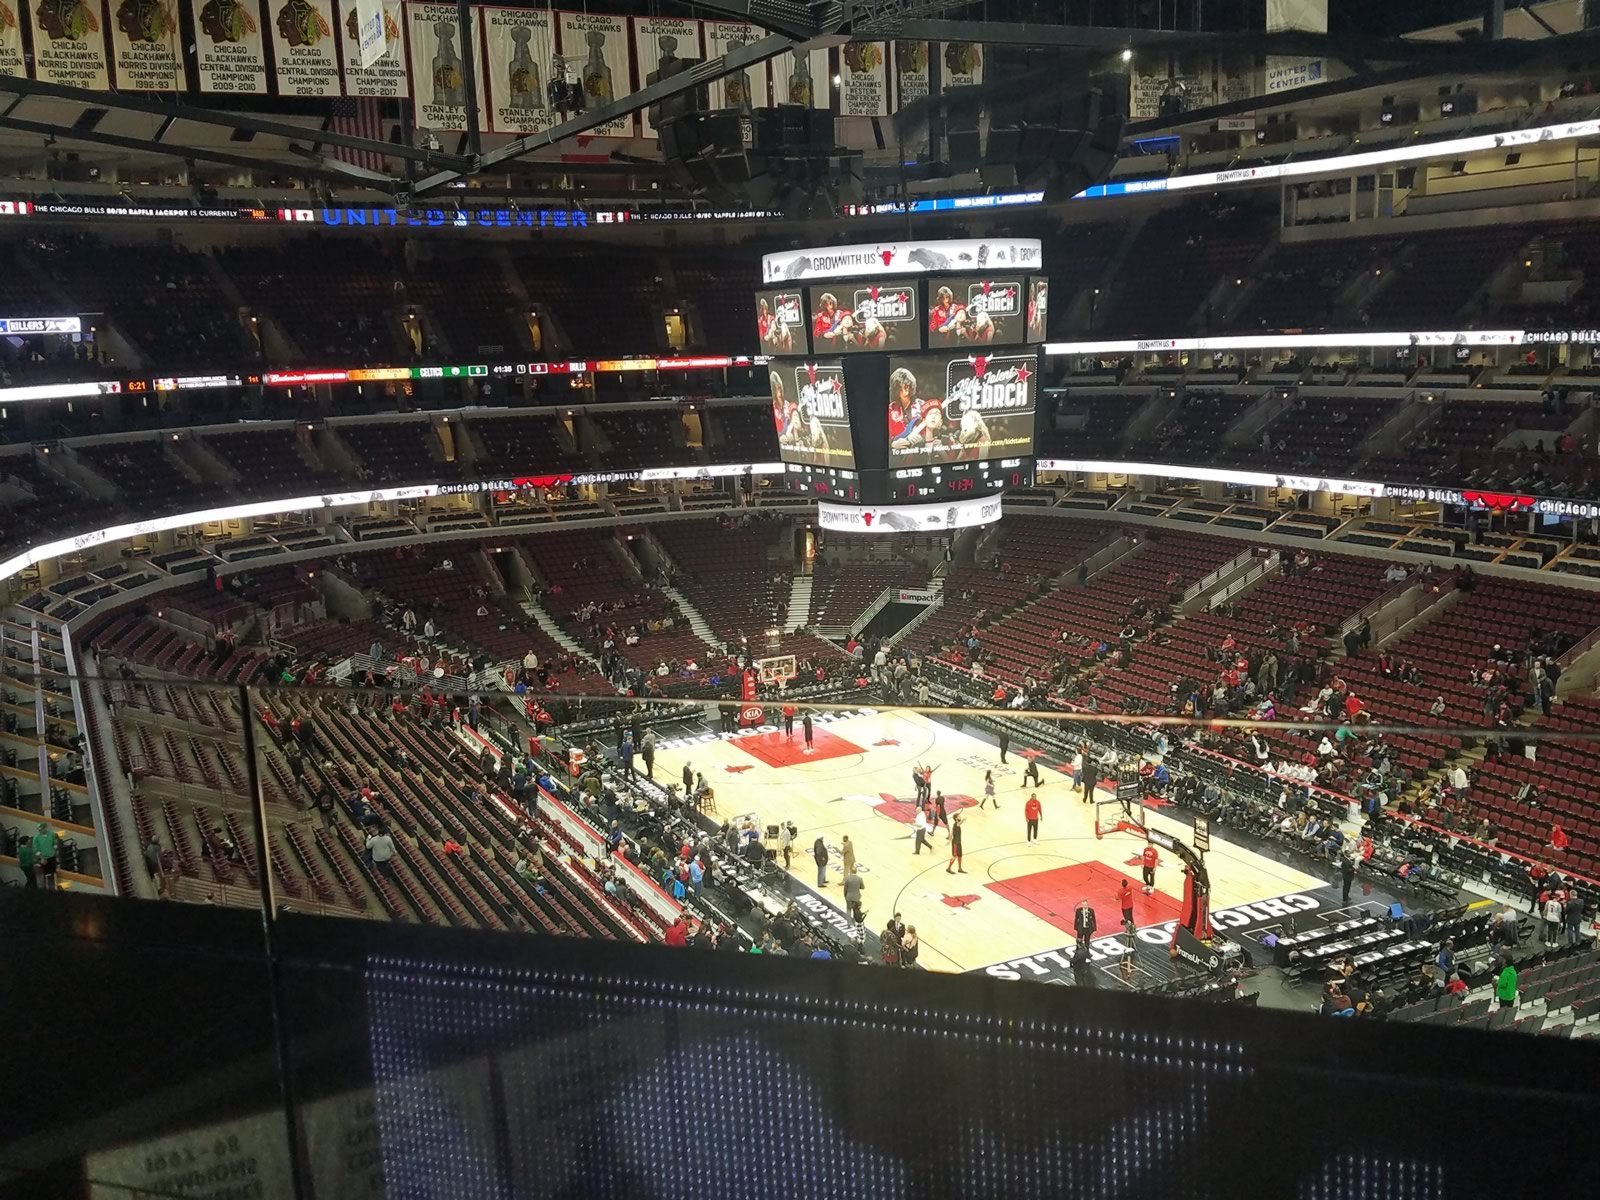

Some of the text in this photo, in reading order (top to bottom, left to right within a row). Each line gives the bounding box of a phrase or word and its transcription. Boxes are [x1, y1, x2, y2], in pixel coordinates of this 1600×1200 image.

[423, 6, 458, 15] CHICAG
[501, 10, 538, 19] CHICAGO
[414, 13, 473, 24] BLACKHAW
[491, 18, 548, 28] BLACKHAWKS
[575, 15, 612, 24] CHICAGO
[649, 19, 685, 28] CHICAGO
[566, 22, 622, 33] BLACKHAWKS
[641, 26, 694, 36] BLACKHAWKS
[718, 25, 752, 34] CHICAGO
[710, 32, 761, 42] BLACKHAWKS
[52, 41, 88, 50] CHICAGO
[131, 43, 166, 52] CHICAGO
[213, 45, 248, 54] CHICAGO
[42, 50, 99, 60] BLACKHAWKS
[122, 51, 176, 61] BLACKHAWKS
[290, 48, 322, 57] CHICAGO
[205, 54, 258, 63] BLACKHAWKS
[282, 57, 332, 67] BLACKHAWKS
[350, 58, 400, 67] BLHAWKS
[38, 60, 105, 70] NORRIS DIVISION
[118, 61, 183, 71] NORRIS DIVISION
[199, 63, 265, 73] CENTRAL DIVISION
[48, 70, 96, 79] CHAMPIONS
[128, 71, 175, 80] CHAMPIONS
[277, 67, 339, 76] CENTRAL DIVISION
[345, 68, 406, 77] CENTRAL DIVISION
[1269, 65, 1307, 79] UNITED
[211, 73, 256, 82] CHAMPIONS
[288, 77, 330, 86] CHAMPIONS
[355, 77, 398, 86] CHAMPIONS
[135, 80, 169, 89] 1992-93
[212, 82, 256, 91] 2009-2010
[845, 80, 882, 88] BLACKHAWKS
[1269, 76, 1306, 90] CENTER
[296, 86, 324, 95] 2012-13
[358, 87, 397, 96] 2016-2017
[845, 94, 882, 102] CONFERENCE
[422, 105, 480, 115] STANLEY CP
[848, 101, 880, 109] CHAMPIONS
[427, 113, 467, 122] CHAMPIO
[499, 108, 535, 117] STANLEY
[441, 121, 463, 130] 1934
[503, 116, 554, 126] CHAMPIONS
[519, 124, 540, 133] 1938
[593, 127, 612, 136] 1961
[1216, 172, 1230, 182] RUN
[49, 205, 83, 213] CHICAGO
[322, 207, 588, 227] UNITED CENTER
[813, 252, 876, 271] GROW WITH US
[976, 297, 1014, 312] SEARCH
[863, 302, 907, 318] SEARCH
[1527, 331, 1600, 342] CHICAGO BULLS
[1137, 341, 1150, 350] RUN
[1163, 340, 1170, 348] US
[420, 367, 443, 377] CELTICS
[493, 365, 513, 374] 41:35
[569, 362, 587, 371] BULLS
[982, 365, 1016, 387] Talent
[128, 381, 146, 390] 6:21
[959, 382, 1028, 412] SEARCH
[806, 393, 844, 418] SEARCH
[577, 474, 612, 483] CHICAGO
[614, 471, 639, 480] BULLS
[896, 468, 923, 478] CELTICS
[1012, 473, 1020, 485] 0
[441, 481, 510, 493] CHICAGO BULLS
[908, 484, 915, 497] 0
[948, 479, 974, 491] 41:34
[1386, 486, 1458, 502] CHICAGO BULLS
[1540, 501, 1587, 515] CHICAGO
[849, 512, 860, 524] US
[907, 594, 934, 602] impact
[746, 709, 760, 718] KIA
[655, 724, 779, 750] HICAGO
[955, 757, 1003, 778] UITED
[969, 755, 1017, 776] CENTER
